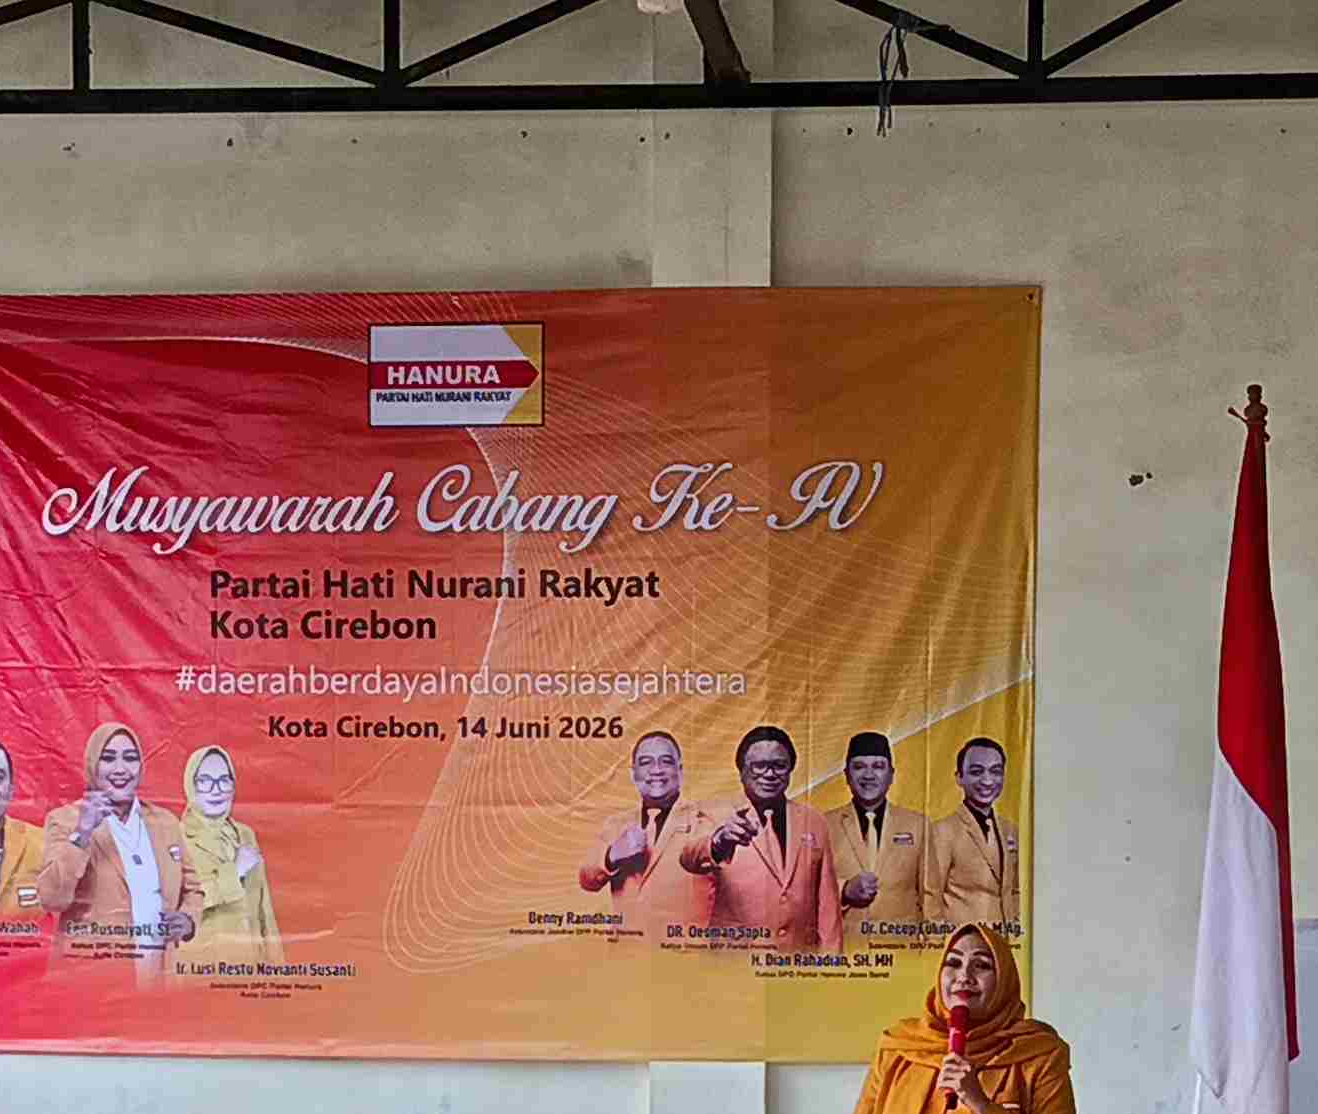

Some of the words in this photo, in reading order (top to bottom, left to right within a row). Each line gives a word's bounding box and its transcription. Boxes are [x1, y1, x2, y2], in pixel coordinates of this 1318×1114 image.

[386, 364, 501, 385] HANURA
[42, 465, 401, 555] Musyawarah
[416, 463, 618, 554] Cabang
[209, 568, 311, 599] Partai
[322, 568, 395, 599] Hati
[407, 569, 526, 599] Nurani
[538, 569, 660, 606] Rakyat
[209, 611, 289, 640] Kota
[300, 609, 437, 641] Cirebon
[175, 664, 747, 703] #daerahberdayaIndonesiasejahtera
[267, 715, 329, 740] Kota
[336, 715, 447, 741] Cirebon,
[458, 716, 487, 739] 14
[496, 716, 551, 740] Juni
[559, 716, 624, 739] 2026
[218, 962, 253, 976] Restu
[256, 962, 307, 977] Novianti
[309, 963, 356, 977] Susanti
